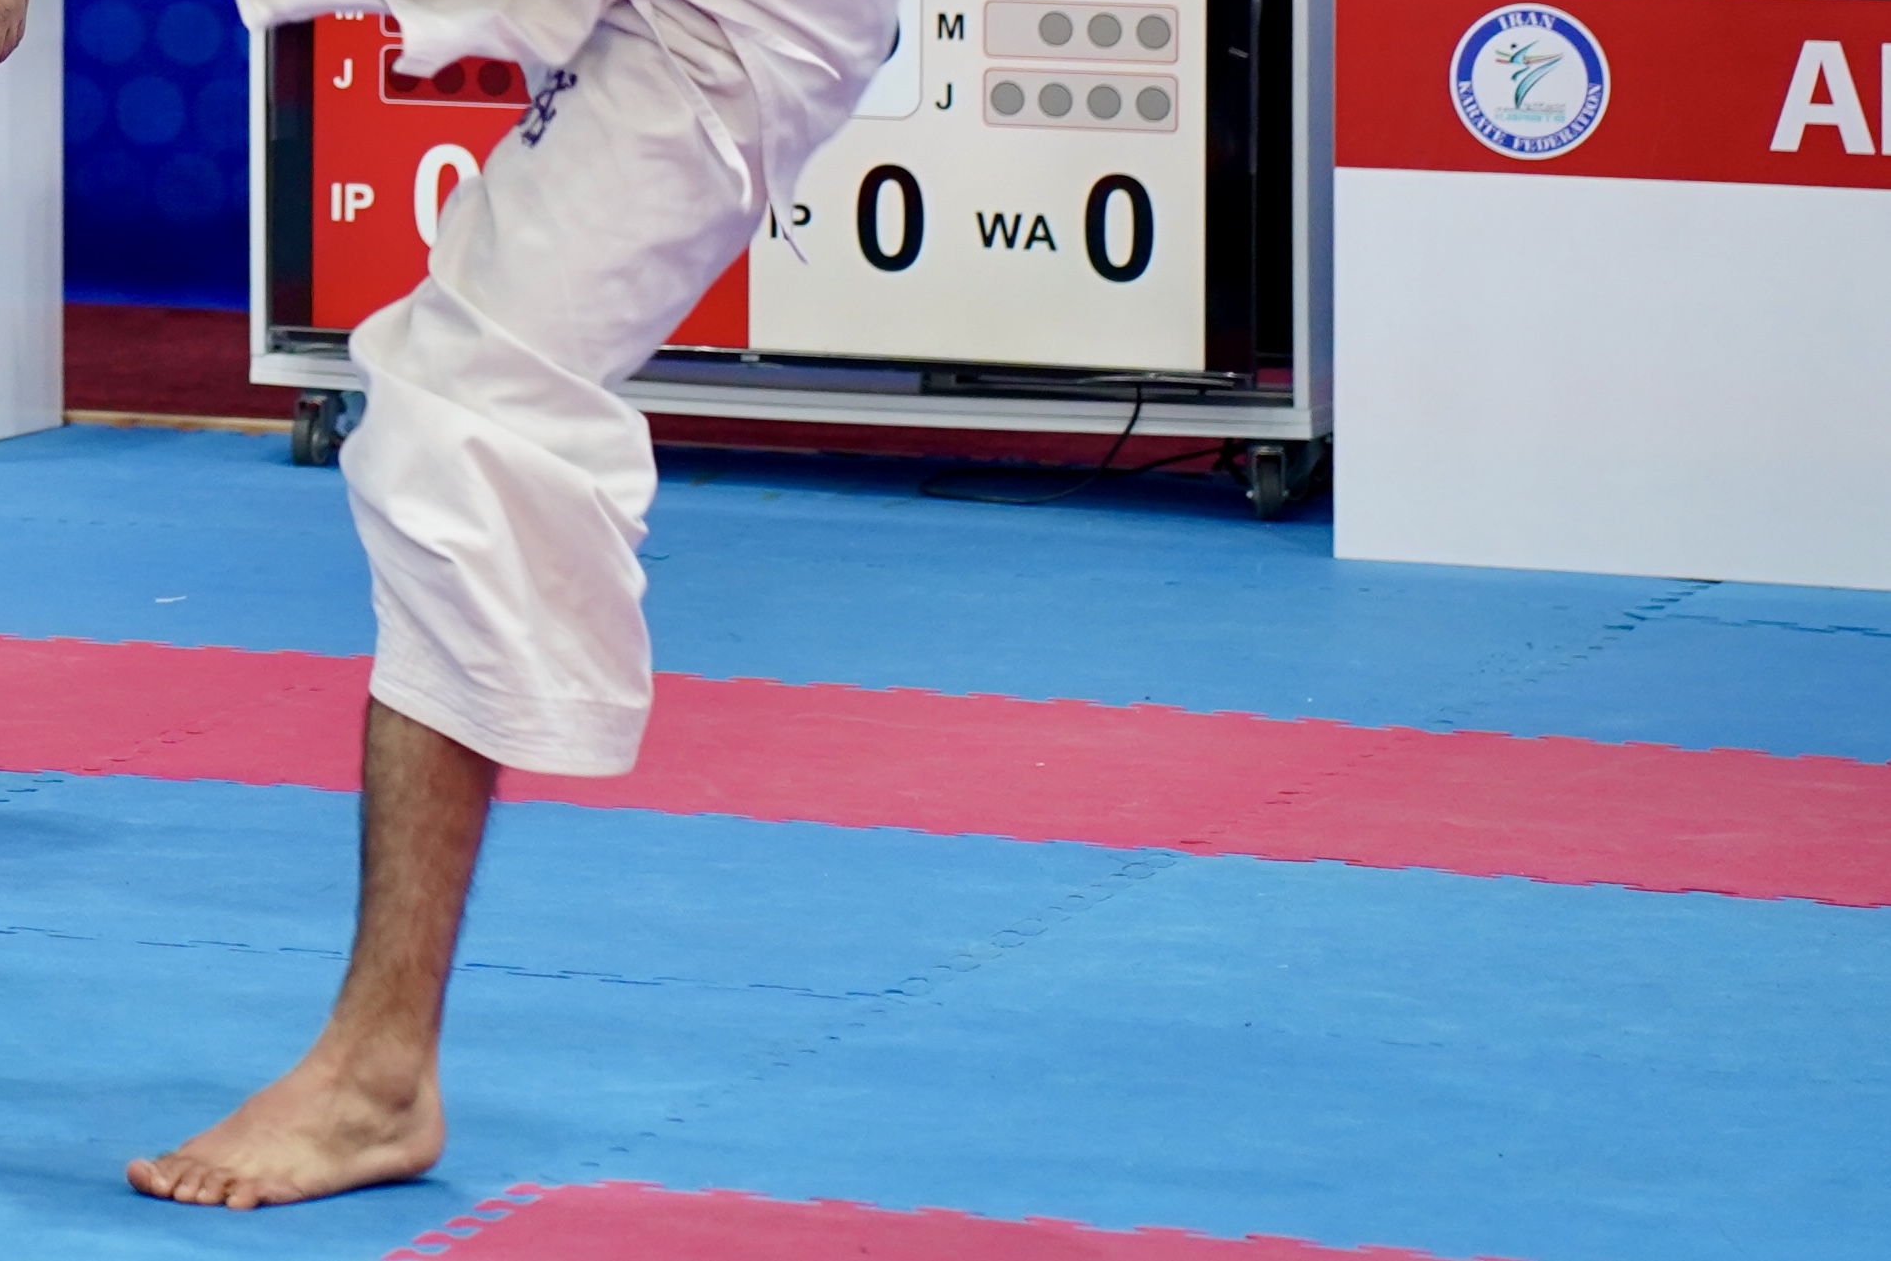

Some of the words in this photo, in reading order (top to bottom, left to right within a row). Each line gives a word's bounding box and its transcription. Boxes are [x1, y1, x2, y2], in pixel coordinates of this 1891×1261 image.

[938, 14, 964, 41] M
[1497, 11, 1556, 31] IRAN
[333, 58, 353, 89] J
[935, 83, 952, 110] J
[1769, 40, 1891, 156] A
[1459, 80, 1508, 145] KARATE
[1511, 83, 1603, 152] FEDERATION
[331, 182, 375, 222] IP
[857, 164, 924, 272] 0
[976, 212, 1057, 251] WA
[1085, 173, 1154, 282] 0
